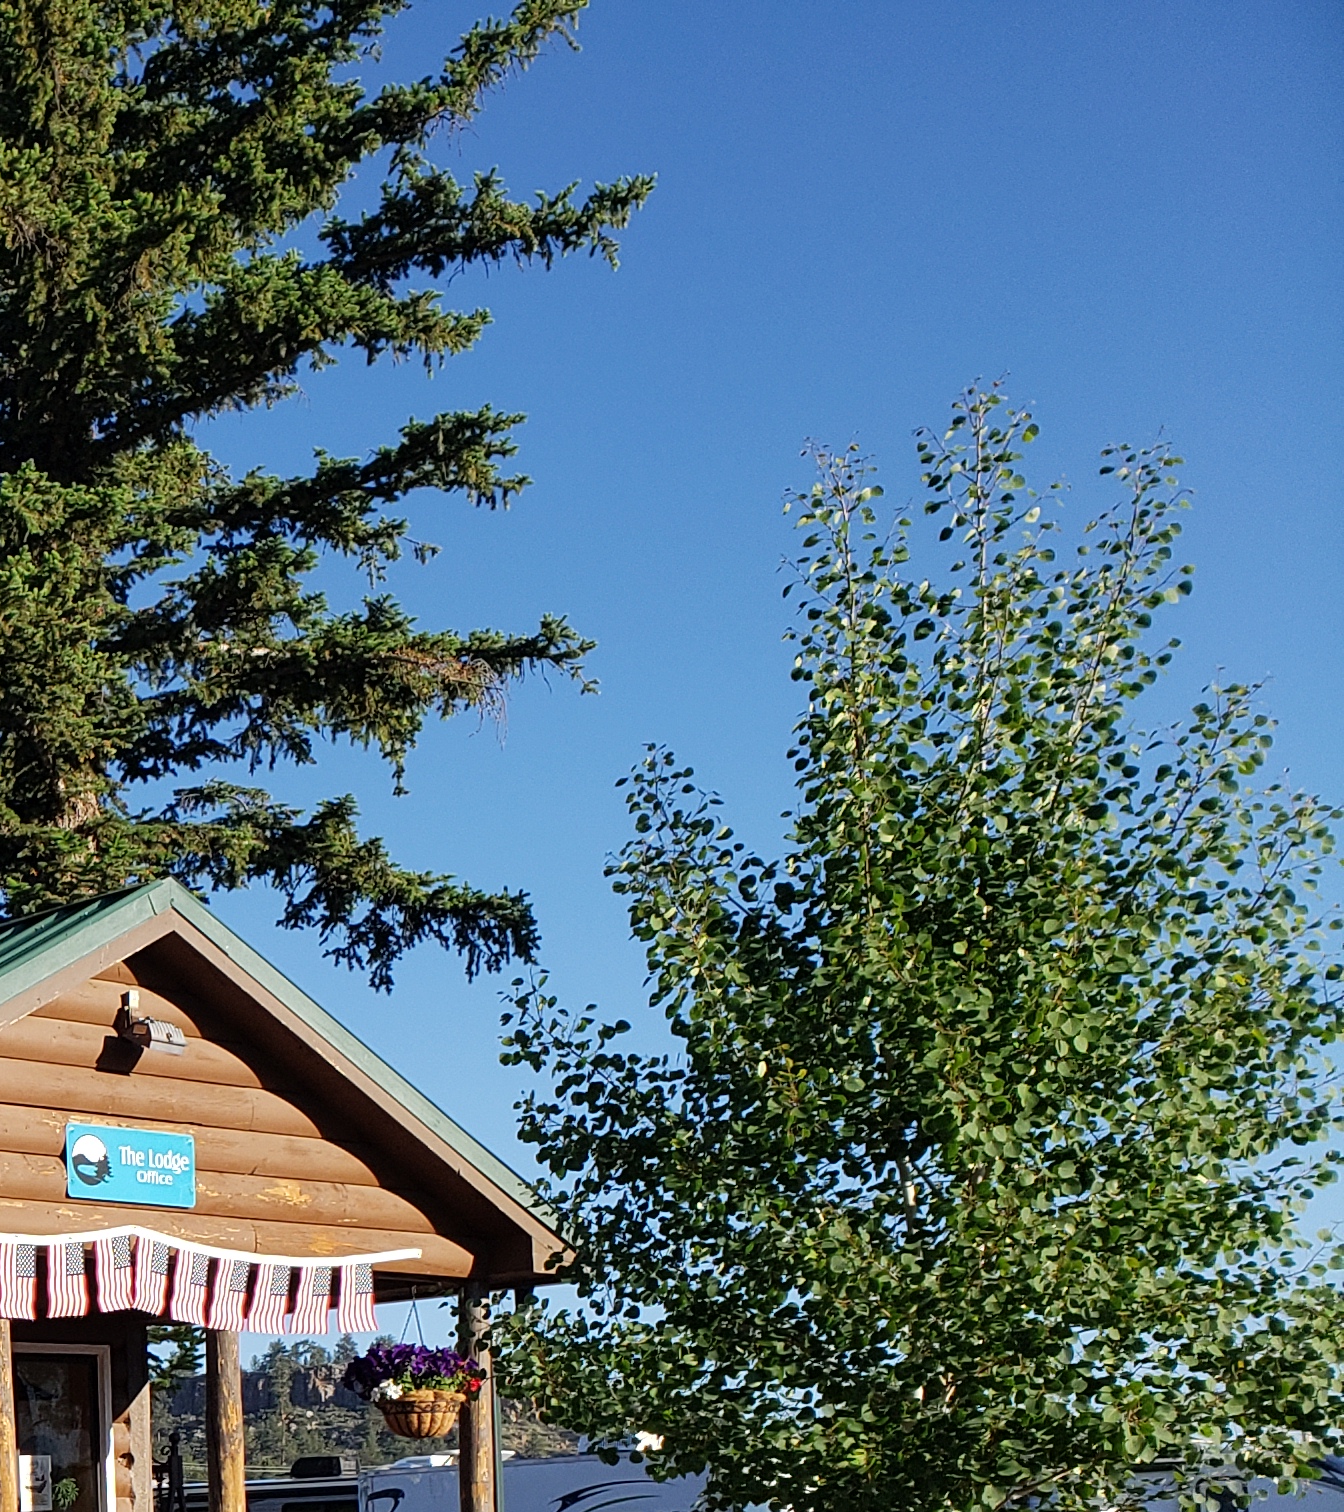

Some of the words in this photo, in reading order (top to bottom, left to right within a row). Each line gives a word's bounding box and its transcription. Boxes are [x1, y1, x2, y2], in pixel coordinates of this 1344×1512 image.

[118, 1145, 145, 1167] The
[148, 1149, 190, 1175] Lodge
[136, 1170, 174, 1186] Office
